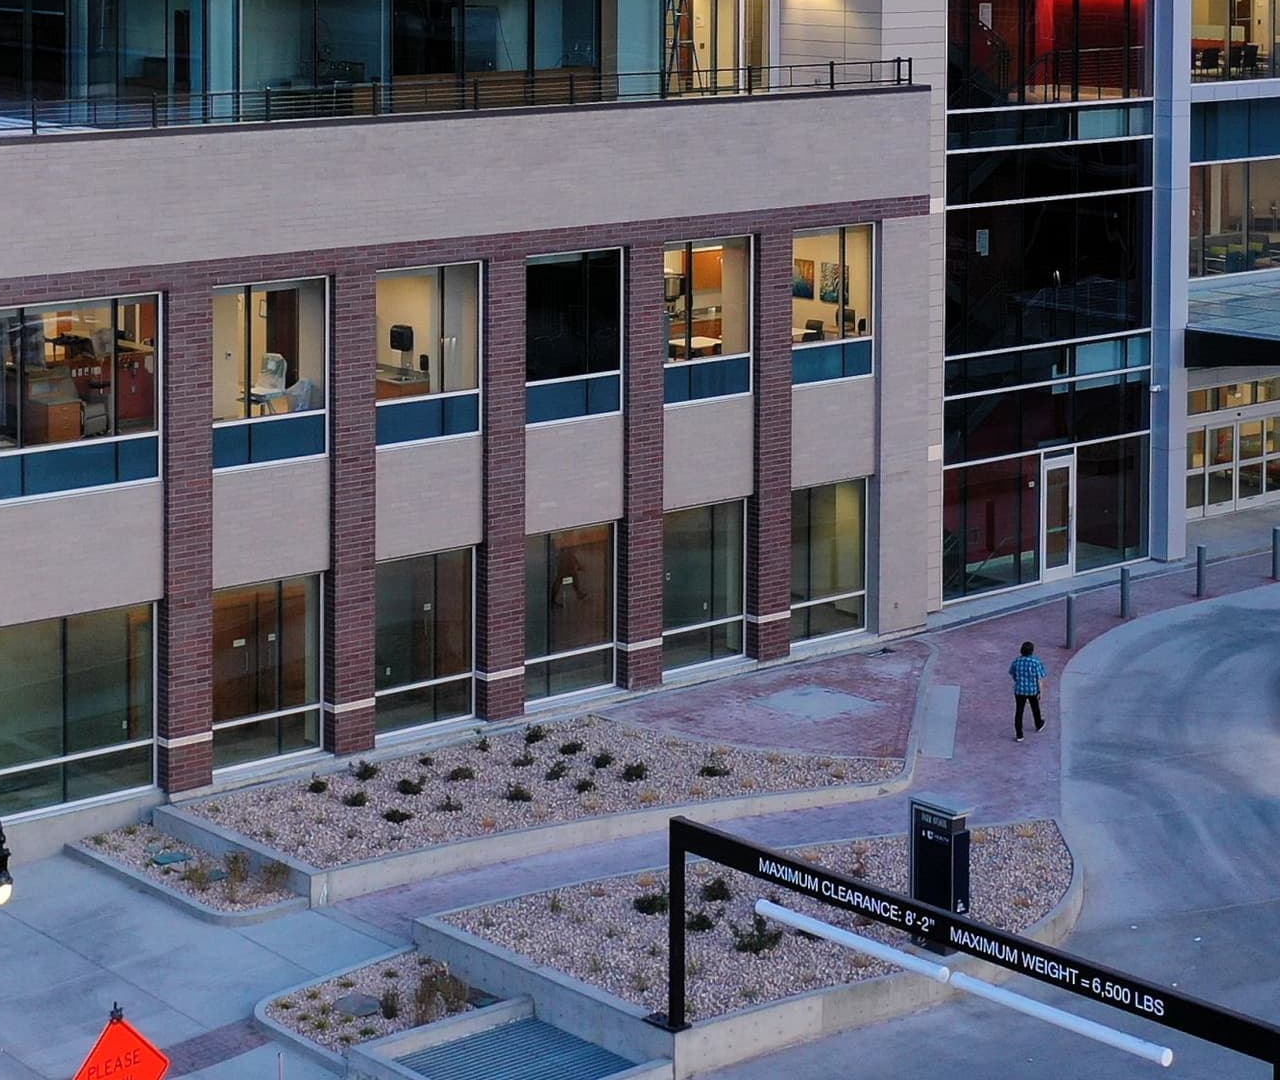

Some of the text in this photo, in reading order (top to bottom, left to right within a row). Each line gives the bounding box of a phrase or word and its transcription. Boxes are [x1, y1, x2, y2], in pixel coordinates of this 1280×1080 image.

[759, 857, 936, 932] MAXIMUM CLEARANCE: 8'-2"
[950, 926, 1018, 964] MAXIMUM
[1021, 951, 1079, 985] WEIGHT
[1092, 977, 1131, 1005] 6,500
[1134, 991, 1165, 1017] LBS
[88, 1048, 141, 1080] PLEASE
